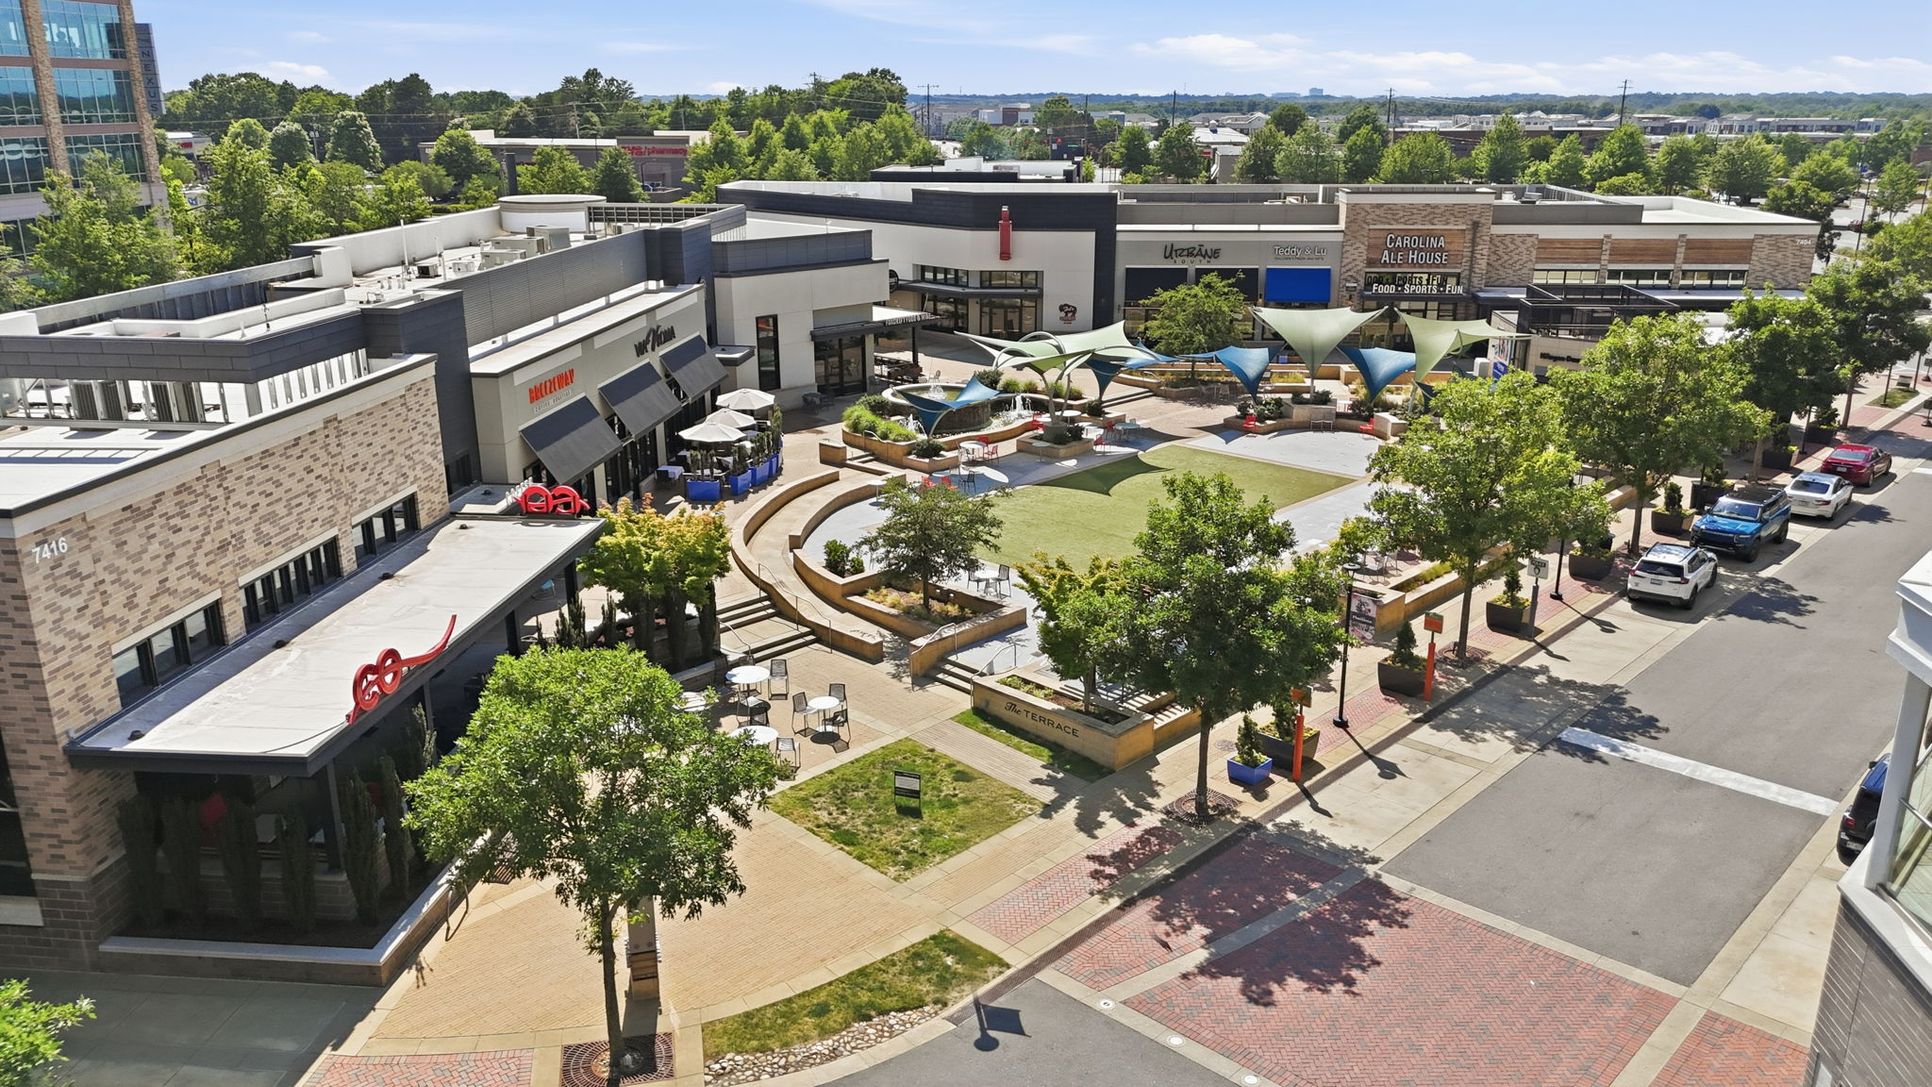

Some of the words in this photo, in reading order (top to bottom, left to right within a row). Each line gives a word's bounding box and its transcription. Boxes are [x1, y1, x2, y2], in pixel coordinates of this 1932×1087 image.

[141, 49, 159, 112] NEXUS
[1387, 233, 1445, 248] CAROLINA
[1274, 246, 1302, 257] Teddy
[1305, 247, 1312, 255] &
[1315, 246, 1327, 256] Lu
[1381, 250, 1404, 264] ALE
[1409, 250, 1449, 264] HOUSE
[1372, 284, 1396, 294] FOOD
[1404, 284, 1438, 294] SPORTS
[1446, 285, 1464, 294] FUN
[528, 367, 575, 404] BREEZEWAY
[31, 537, 68, 564] 7416
[1004, 702, 1021, 714] The
[1024, 709, 1080, 738] TERRACE
